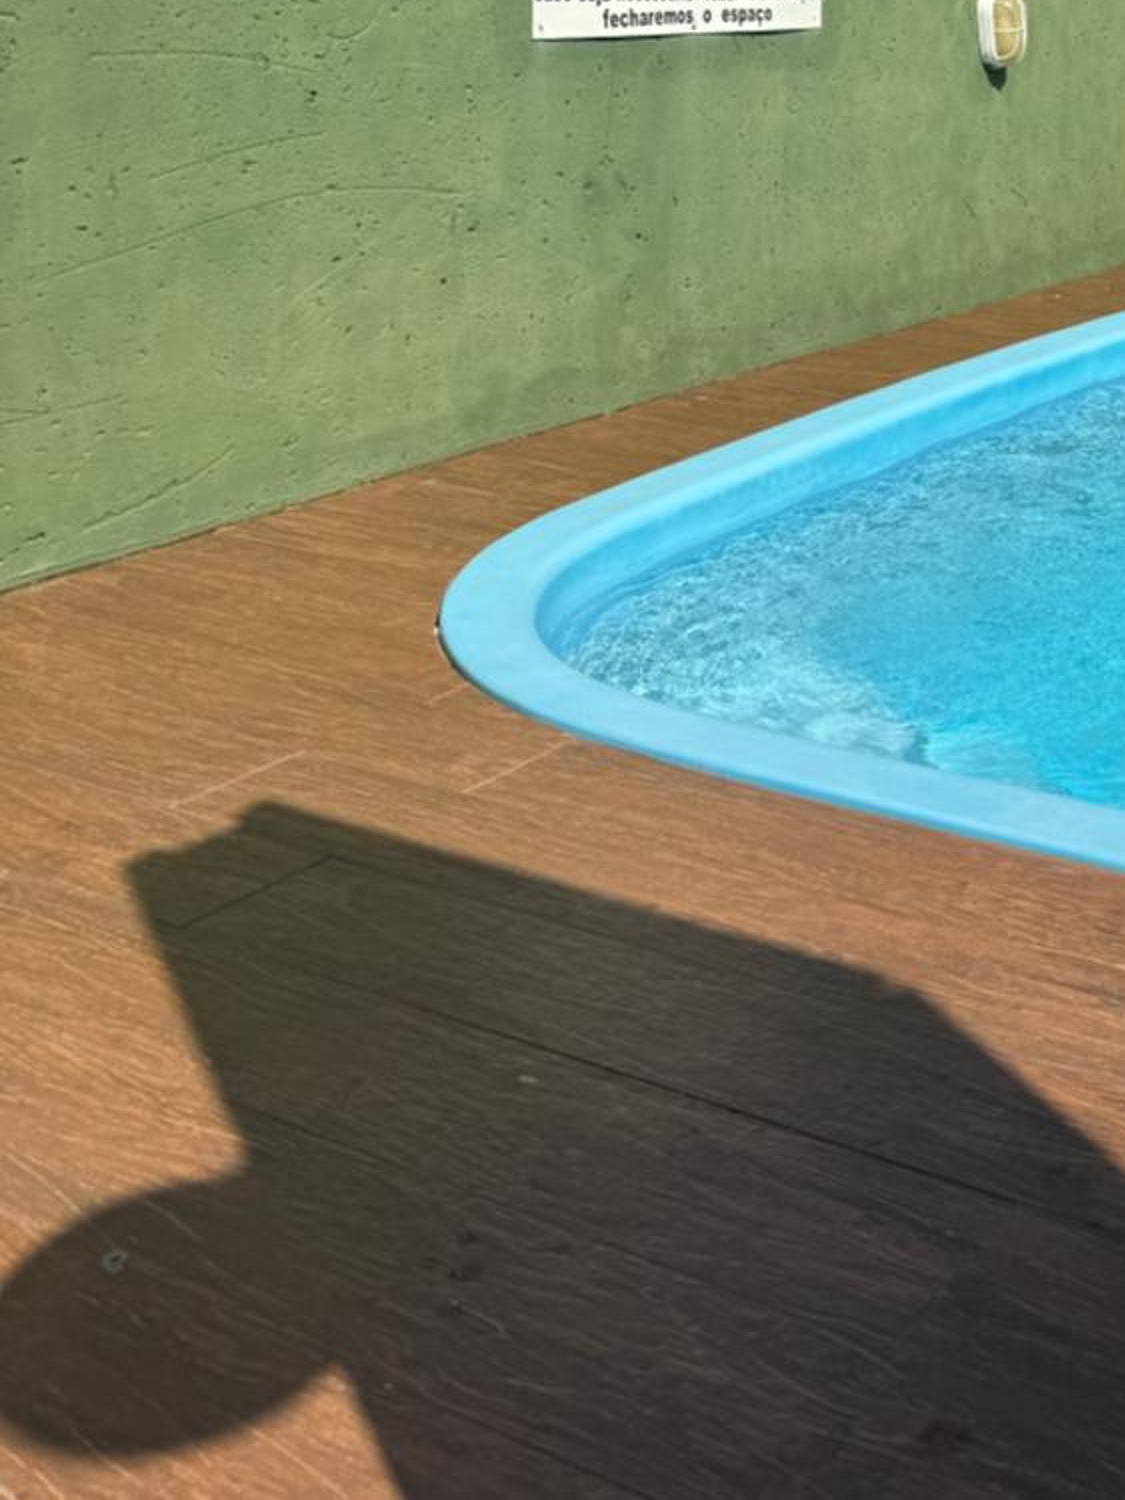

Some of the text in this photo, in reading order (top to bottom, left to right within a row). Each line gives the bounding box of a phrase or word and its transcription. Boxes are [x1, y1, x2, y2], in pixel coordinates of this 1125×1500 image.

[603, 7, 773, 29] fecharemos o espaço
